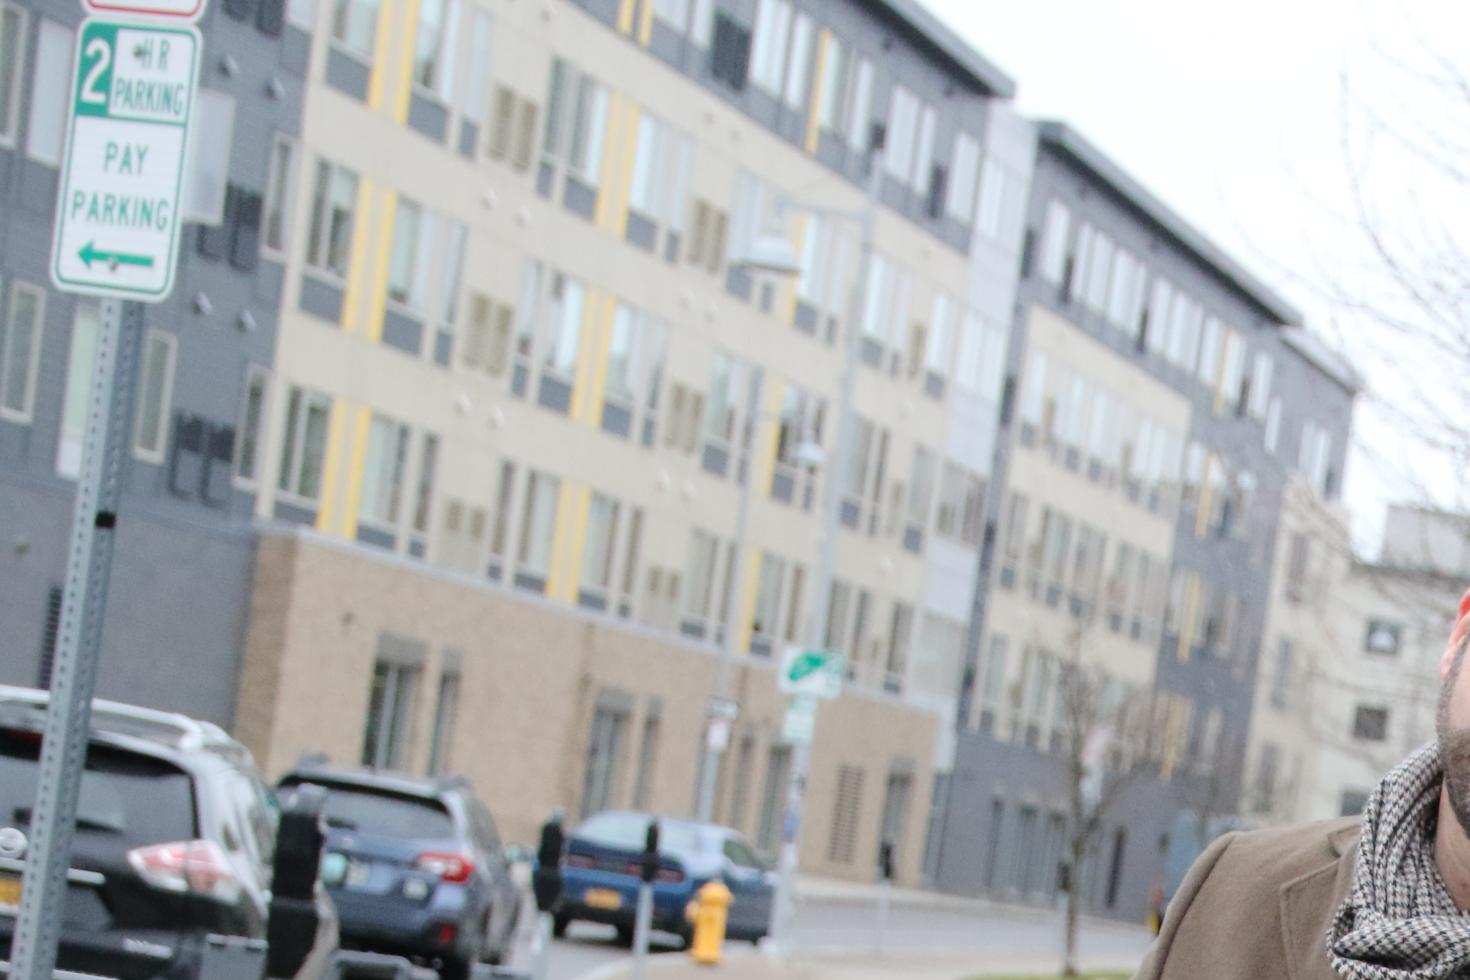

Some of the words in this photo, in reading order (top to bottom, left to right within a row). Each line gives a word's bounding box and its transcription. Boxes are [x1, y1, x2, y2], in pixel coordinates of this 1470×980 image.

[81, 37, 111, 103] 2
[140, 38, 171, 70] HR
[113, 77, 185, 116] PARKING
[103, 141, 149, 175] PAY
[71, 189, 170, 231] PARKING
